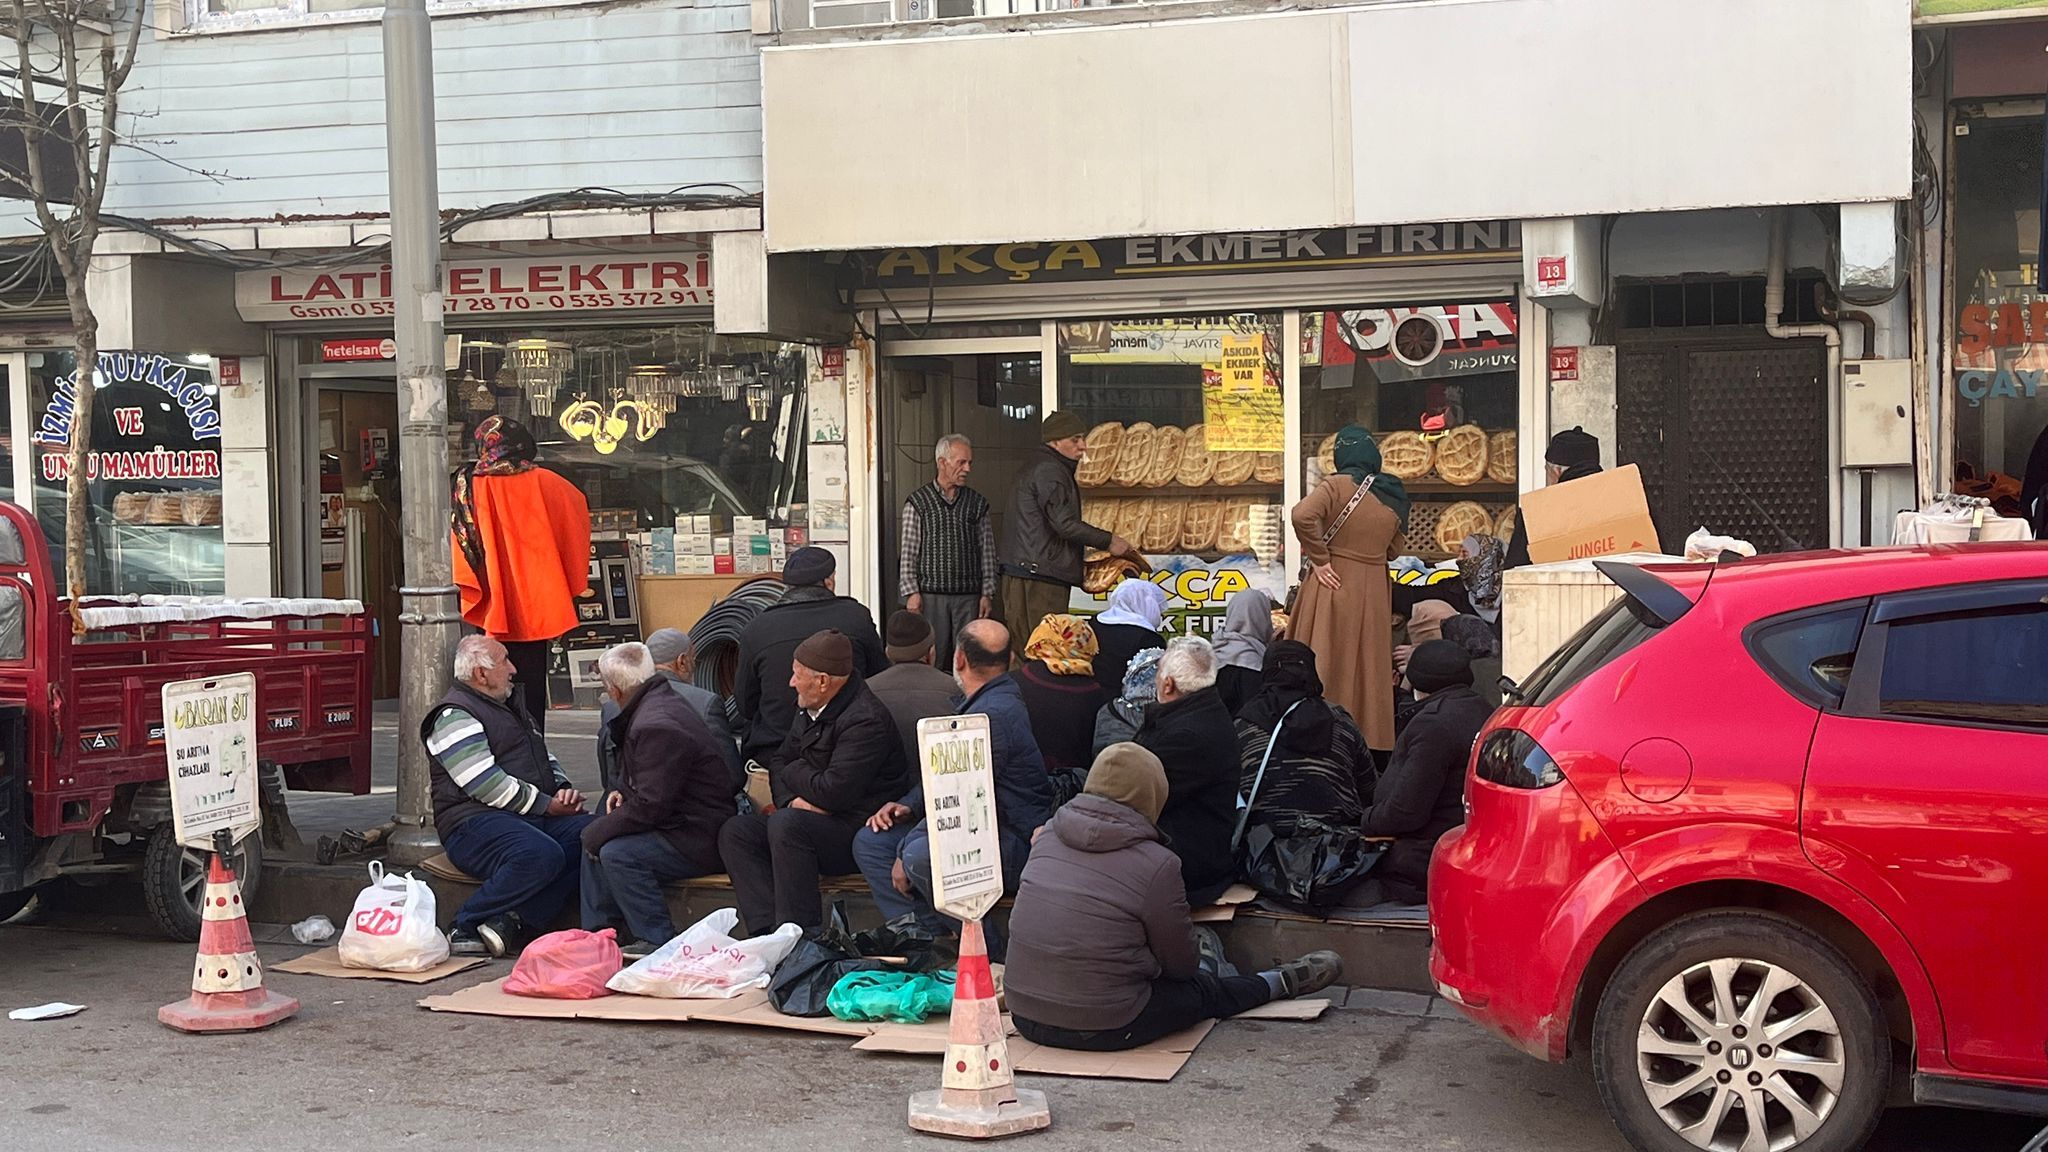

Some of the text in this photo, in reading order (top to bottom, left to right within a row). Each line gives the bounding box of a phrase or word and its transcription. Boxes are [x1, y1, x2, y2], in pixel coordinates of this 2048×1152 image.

[877, 240, 1101, 281] AKÇA
[1125, 231, 1326, 265] EKMEK
[271, 253, 710, 302] LATİ ELEKTRİ
[1545, 265, 1561, 278] 13
[290, 304, 349, 318] Gsm:
[351, 302, 367, 316] 0
[465, 297, 496, 311] 28
[500, 296, 530, 310] 70
[549, 294, 566, 309] 0
[569, 292, 615, 308] 535
[621, 291, 666, 306] 372
[670, 290, 699, 304] 91
[1223, 347, 1259, 357] ASKIDA
[1226, 358, 1261, 369] EKMEK
[1233, 370, 1254, 380] VAR
[114, 408, 144, 435] VE
[43, 446, 220, 480] UNU MAMÜLLER
[1568, 536, 1616, 560] JUNGLE
[183, 692, 249, 729] BARAN SU
[275, 717, 293, 728] PLUS
[334, 711, 350, 722] 2000
[176, 748, 186, 760] SU
[937, 738, 970, 776] BARAN
[934, 797, 942, 810] SU
